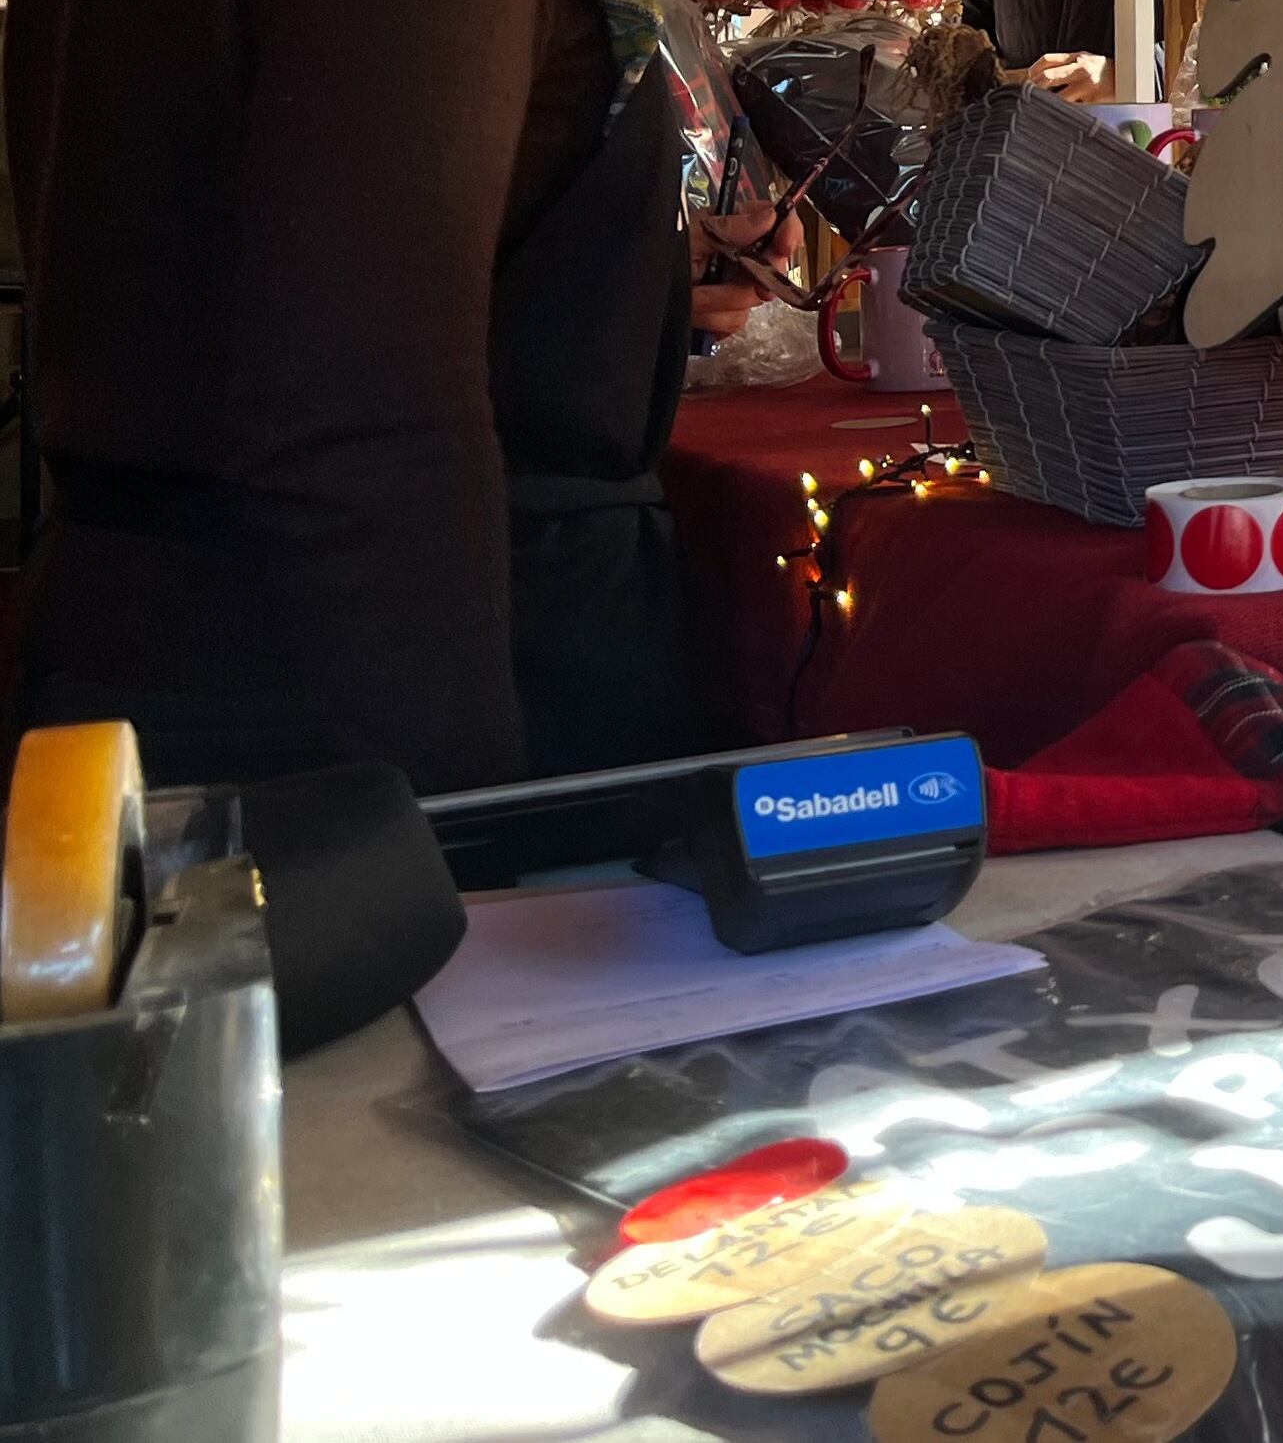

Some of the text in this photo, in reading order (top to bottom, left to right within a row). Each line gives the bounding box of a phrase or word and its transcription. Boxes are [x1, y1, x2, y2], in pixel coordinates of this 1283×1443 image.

[776, 781, 900, 823] Sabadell
[771, 1243, 946, 1332] SACO
[932, 1297, 1134, 1436] COJÍN
